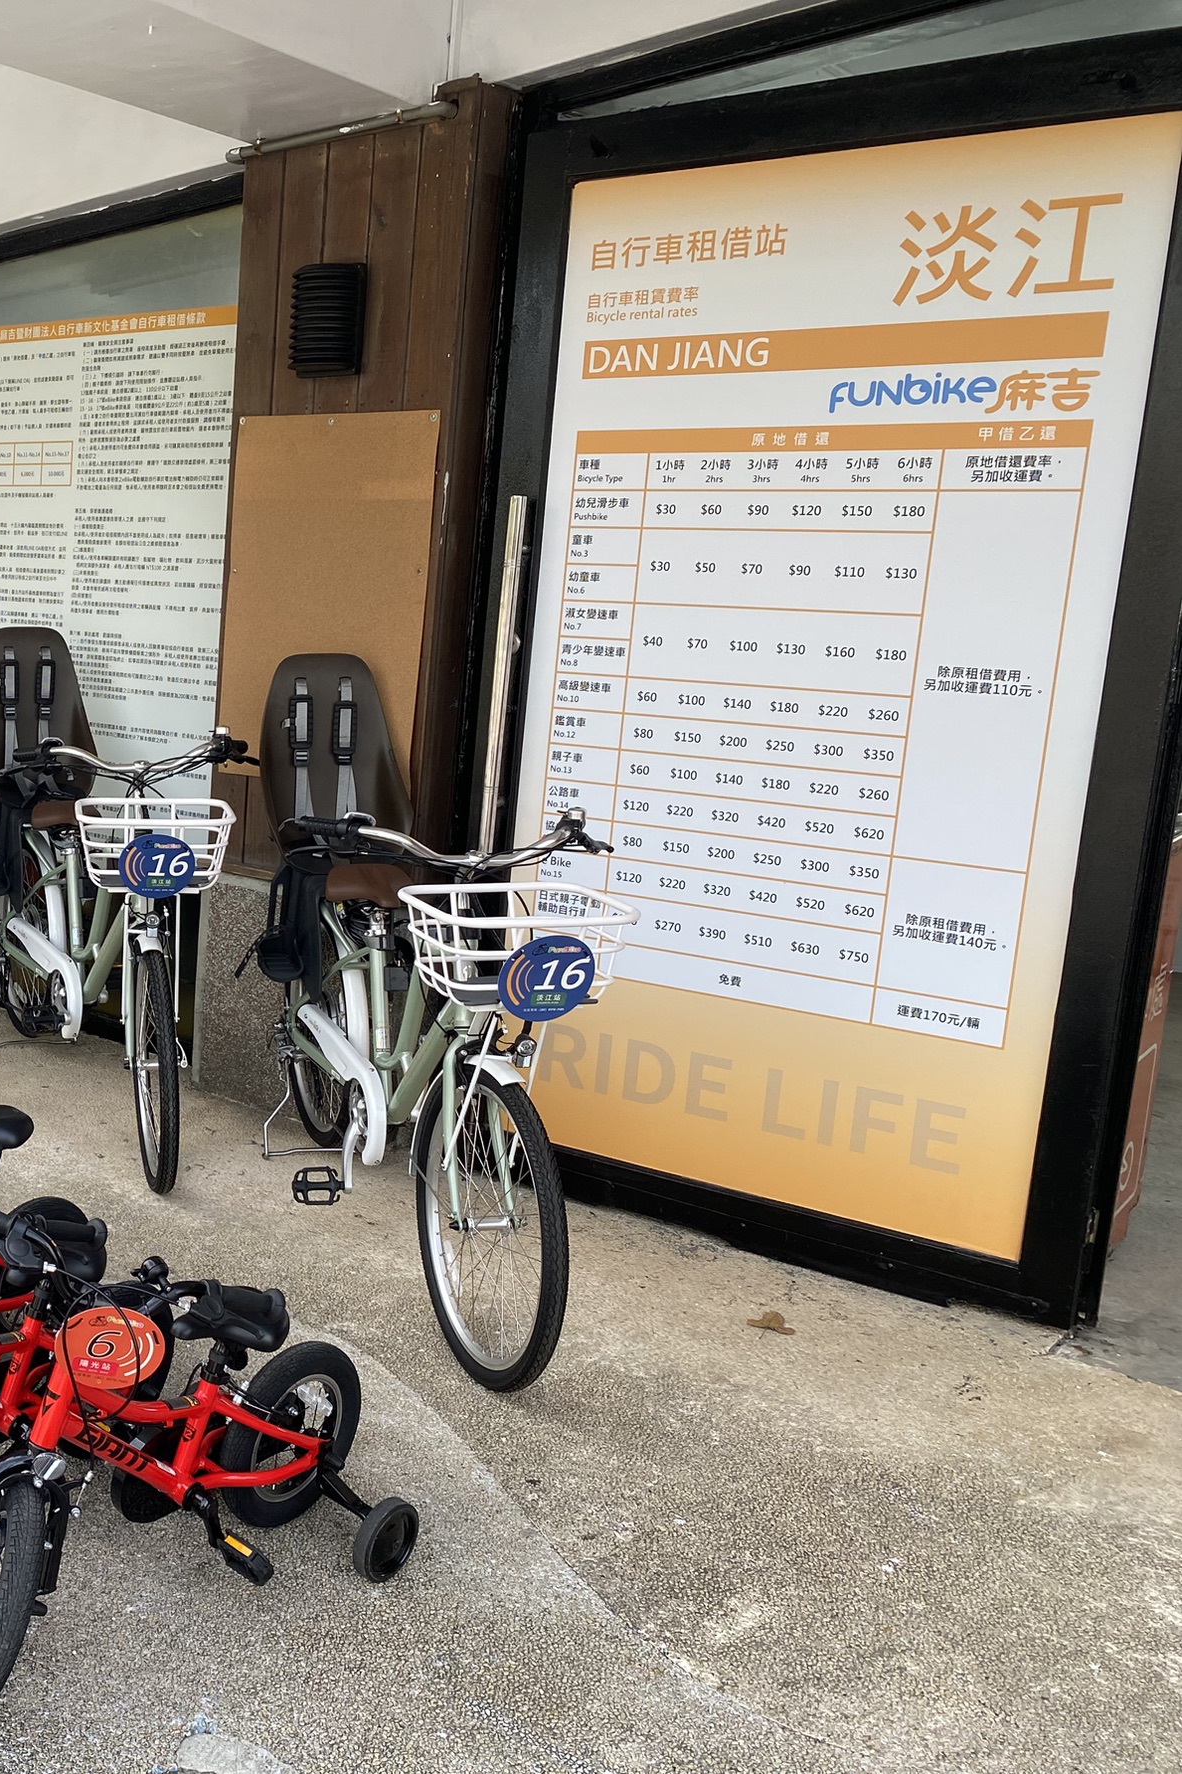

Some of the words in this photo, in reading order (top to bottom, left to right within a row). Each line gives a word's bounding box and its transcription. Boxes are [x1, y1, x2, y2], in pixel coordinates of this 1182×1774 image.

[590, 222, 789, 272] 自行車租借站
[892, 191, 1124, 307] 淡江
[586, 285, 700, 309] 自行車租賃費率
[586, 308, 625, 326] Bicycle
[630, 306, 663, 322] rental
[666, 305, 698, 320] rates
[588, 342, 659, 376] DAN
[666, 336, 771, 372] JIANG
[751, 432, 830, 447] 原地借還
[978, 425, 1057, 442] 甲借乙還
[579, 459, 600, 470] 車種
[656, 460, 684, 471] 1小時
[701, 459, 731, 470] 2小時
[748, 459, 779, 470] 3小時
[795, 458, 828, 470] 4小時
[846, 458, 879, 469] 5小時
[898, 457, 932, 469] 6小時
[578, 475, 603, 484] Bicycle
[605, 475, 623, 483] Type
[663, 475, 676, 483] 1hr
[706, 475, 723, 483] 2hrs
[851, 474, 870, 482] 5hrs
[903, 474, 923, 482] 6hrs
[575, 498, 629, 508] 幼兒滑步車
[656, 504, 676, 515] $30
[701, 504, 721, 515] $60
[748, 505, 769, 516] $90
[792, 505, 821, 516] $120
[842, 505, 872, 517] $150
[893, 505, 925, 517] $180
[572, 534, 593, 545] 童車
[569, 571, 600, 582] 幼童車
[651, 561, 670, 571] $30
[695, 562, 715, 573] $50
[742, 563, 762, 574] $70
[789, 565, 810, 576] $90
[835, 566, 864, 578] $110
[886, 567, 917, 579] $130
[561, 644, 626, 657] 青少年變速車
[643, 636, 662, 646] $40
[687, 638, 707, 649] $70
[730, 640, 757, 652] $100
[777, 643, 805, 655] $130
[825, 646, 855, 658] $160
[876, 649, 906, 661] $180
[558, 680, 611, 693] 高級變速車
[637, 691, 657, 702] $60
[678, 694, 705, 706] $100
[724, 697, 751, 709] $140
[770, 701, 798, 713] $180
[818, 705, 848, 717] $220
[868, 708, 899, 721] $260
[555, 715, 586, 727] 鑑賞車
[554, 730, 575, 738] No.12
[634, 728, 653, 739] $80
[674, 731, 701, 743] $150
[720, 735, 747, 747] $200
[766, 739, 794, 752] $250
[814, 744, 843, 756] $300
[864, 748, 894, 761] $350
[551, 751, 582, 763] 親子車
[551, 765, 572, 773] No.13
[630, 764, 649, 775] $60
[671, 768, 697, 780] $100
[716, 773, 743, 785] $140
[762, 777, 790, 790] $180
[810, 782, 838, 795] $220
[859, 788, 889, 801] $260
[548, 786, 579, 798] 公路車
[546, 800, 568, 809] No.14
[623, 800, 649, 812] $120
[667, 805, 693, 817] $220
[712, 810, 739, 822] $320
[758, 815, 785, 828] $420
[805, 821, 834, 834] $520
[854, 827, 884, 840] $620
[147, 850, 191, 877] 16
[550, 856, 572, 868] Bike
[623, 836, 642, 847] $80
[663, 841, 689, 853] $150
[708, 847, 734, 859] $200
[753, 853, 781, 866] $250
[801, 859, 829, 872] $300
[849, 865, 879, 879] $350
[541, 869, 562, 878] No.15
[616, 871, 641, 883] $120
[660, 877, 685, 890] $220
[704, 884, 730, 896] $320
[749, 890, 777, 903] $420
[796, 897, 825, 910] $520
[845, 904, 874, 917] $620
[655, 920, 681, 932] $270
[699, 926, 726, 940] $390
[744, 934, 772, 947] $510
[791, 941, 819, 955] $630
[839, 949, 868, 963] $750
[533, 957, 591, 990] 16
[719, 974, 741, 987] 免費
[897, 1002, 980, 1030] 運費170元/輛
[537, 1023, 732, 1123] RIDE
[761, 1067, 967, 1175] LIFE
[86, 1330, 124, 1359] 6
[79, 1359, 111, 1371] 陽光站
[74, 1428, 156, 1472] GIANT
